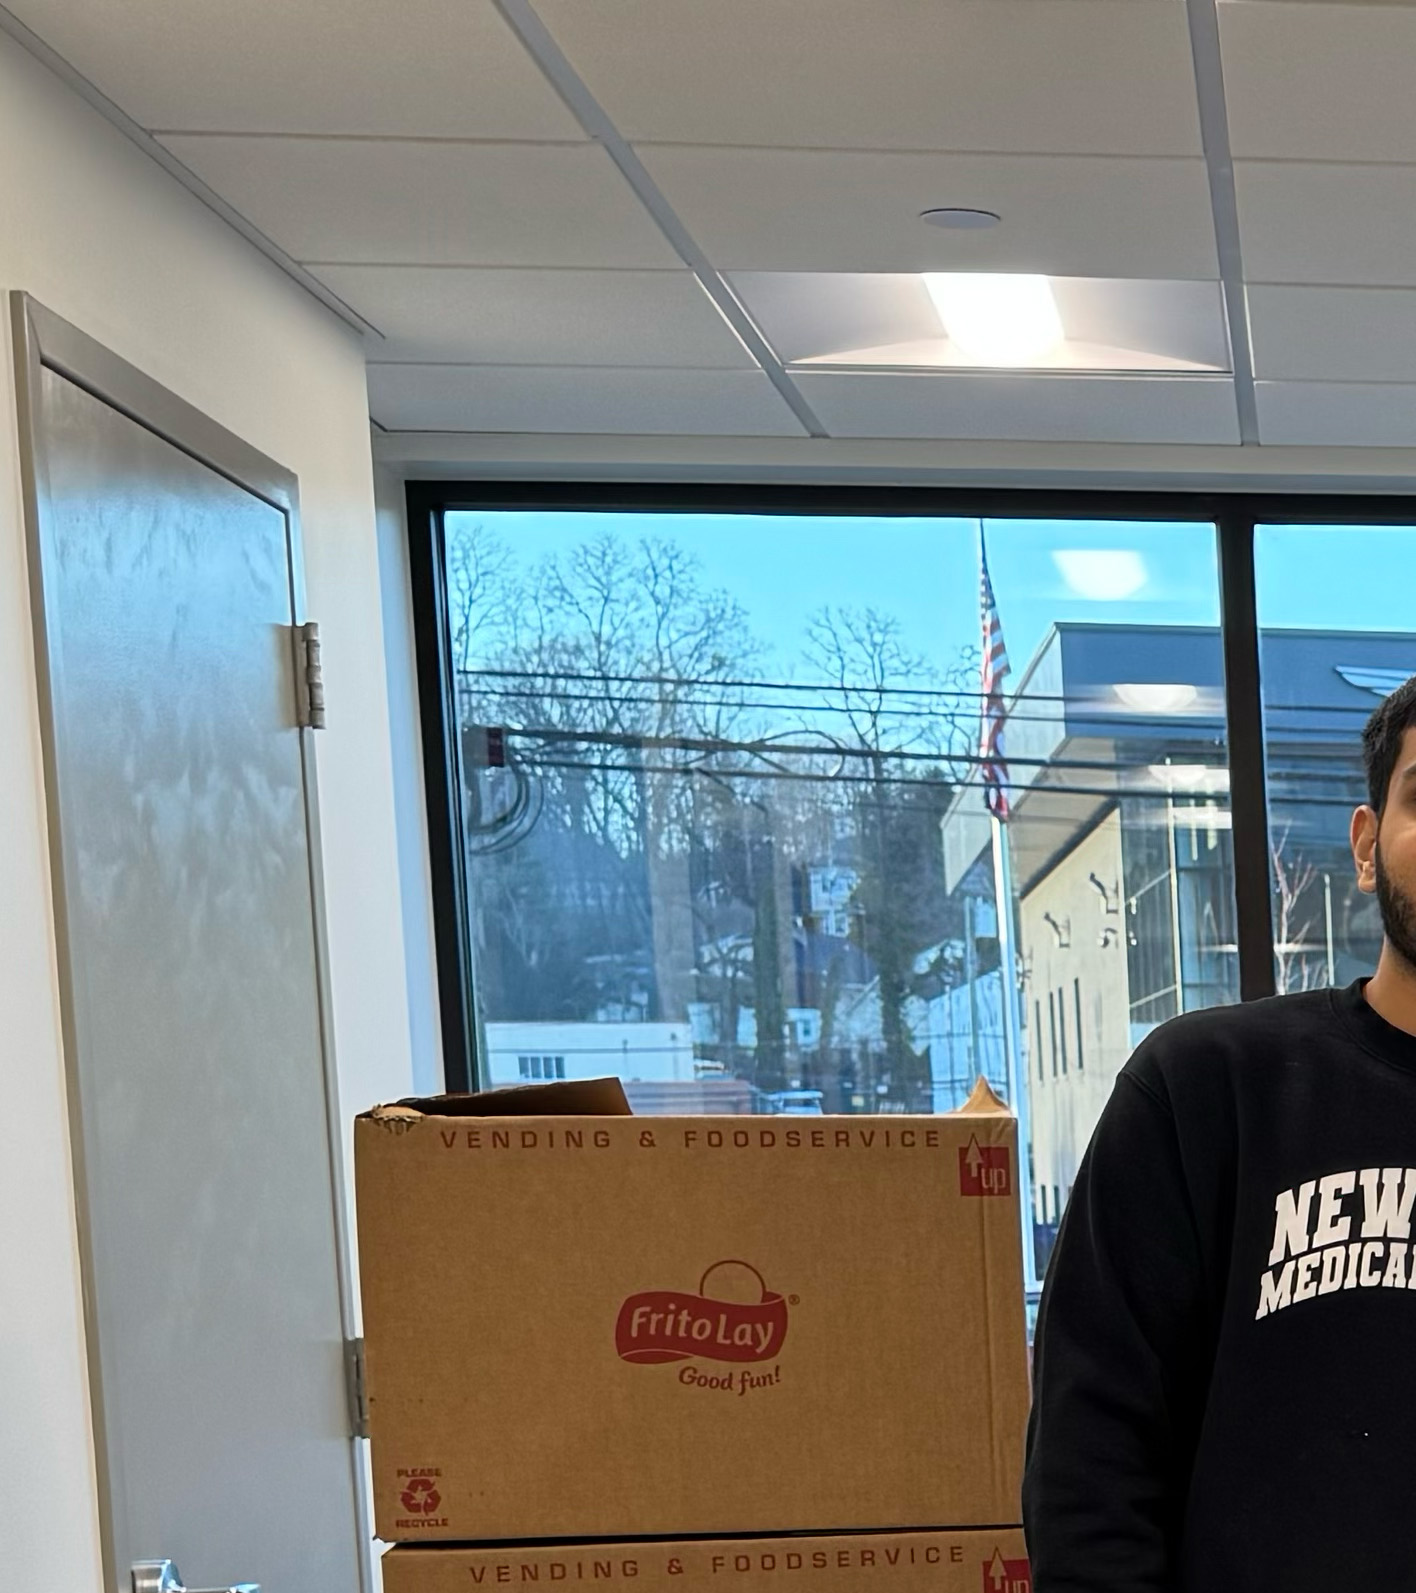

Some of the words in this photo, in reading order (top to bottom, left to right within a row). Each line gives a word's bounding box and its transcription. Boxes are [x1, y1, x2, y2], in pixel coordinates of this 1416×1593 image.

[440, 1129, 611, 1150] VENDING
[639, 1130, 658, 1149] &
[685, 1129, 942, 1149] FOODSERVICE
[981, 1165, 1008, 1194] up
[678, 1364, 734, 1391] Good
[738, 1366, 782, 1396] fun!
[397, 1468, 442, 1478] PLEASE
[395, 1518, 449, 1528] RECYCLE
[469, 1558, 640, 1584] VENDING
[667, 1557, 685, 1576] &
[711, 1545, 967, 1573] FOODSERVICE
